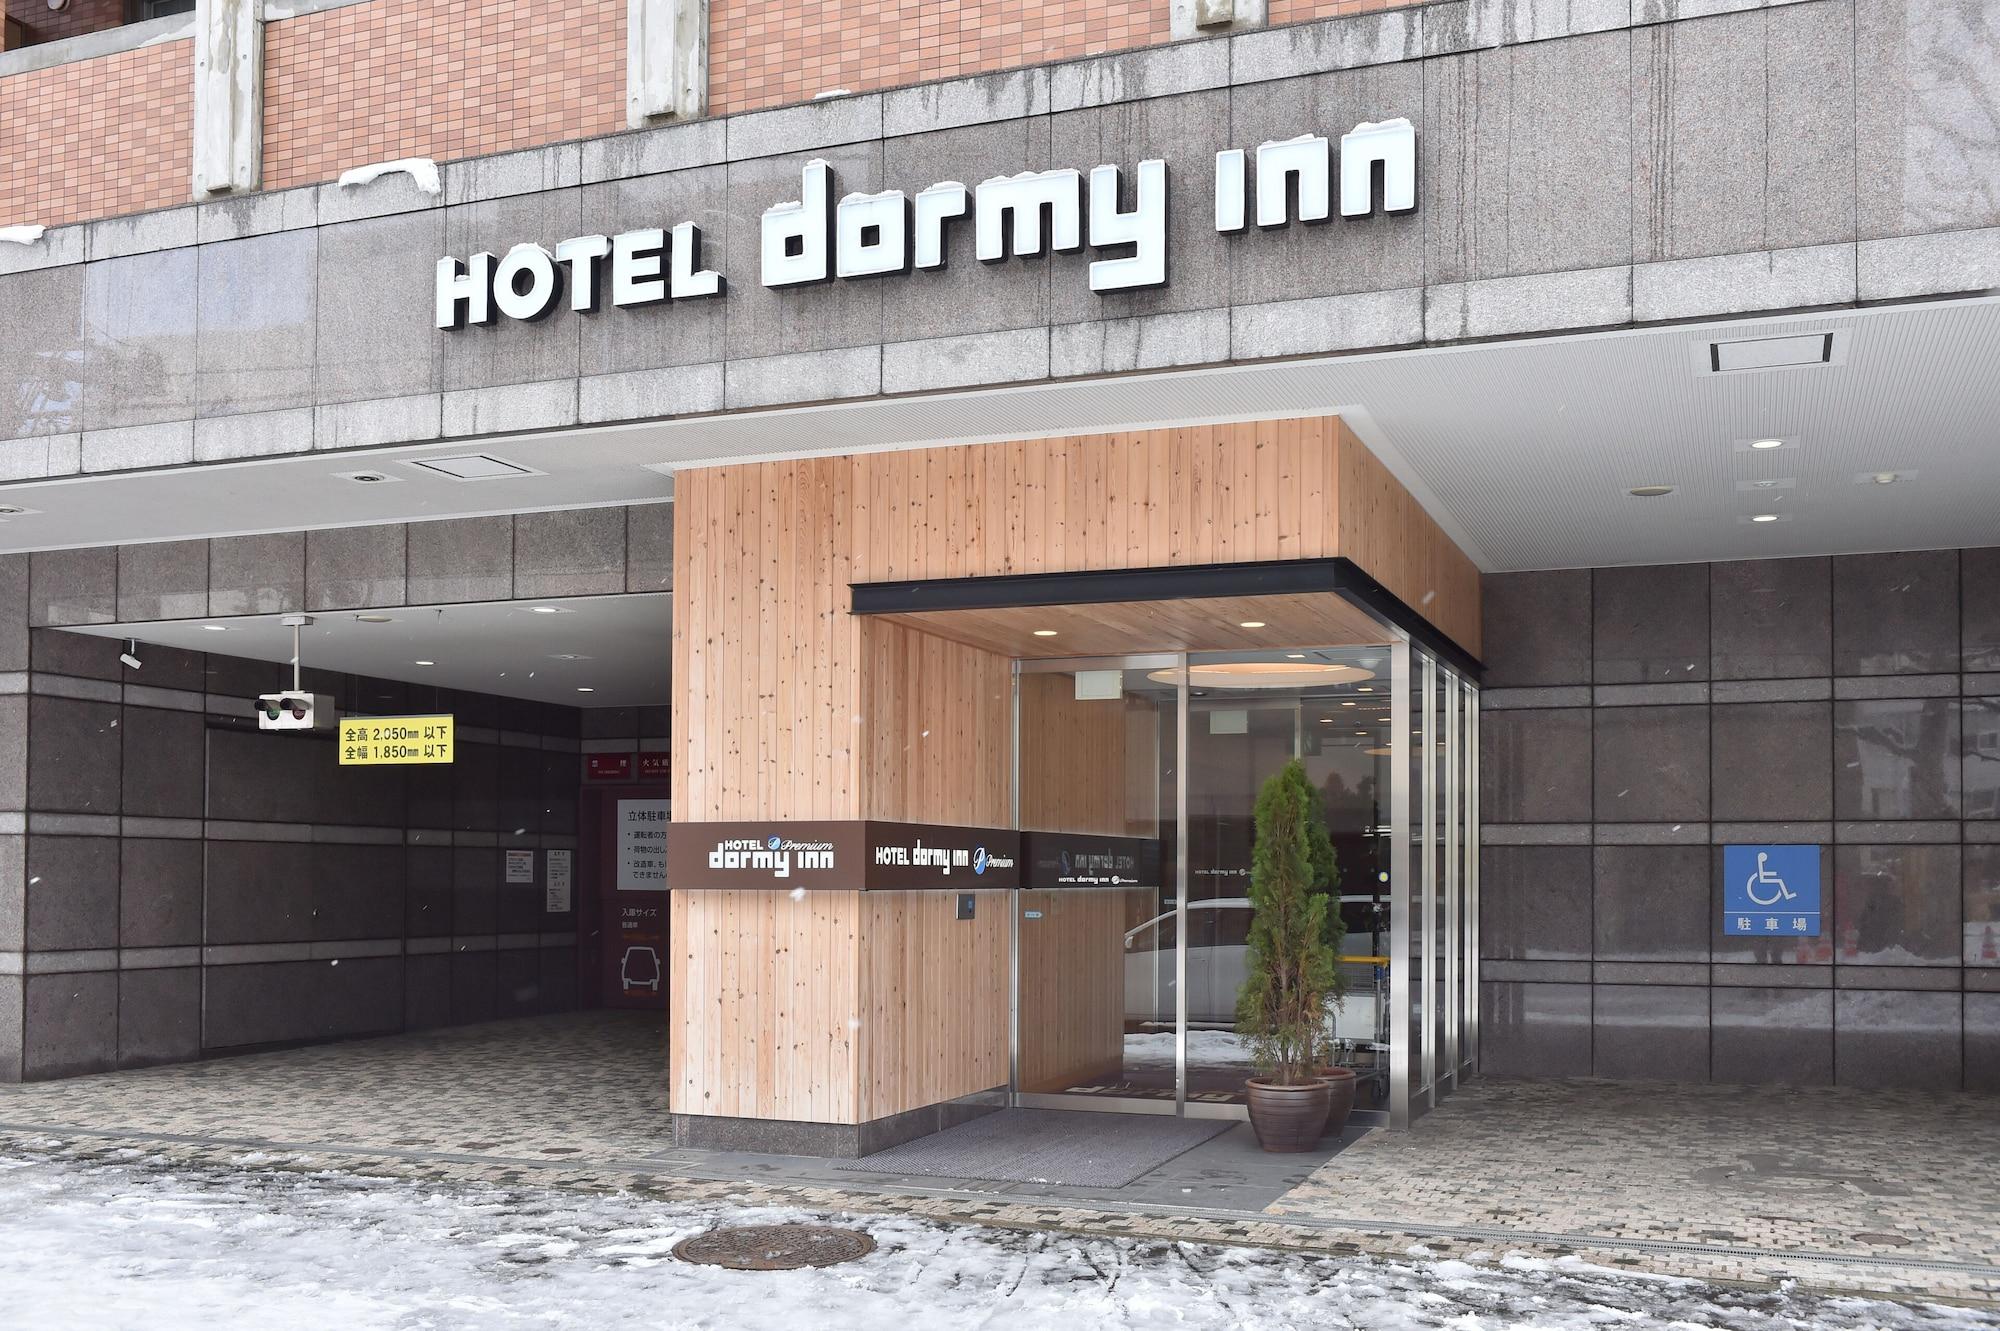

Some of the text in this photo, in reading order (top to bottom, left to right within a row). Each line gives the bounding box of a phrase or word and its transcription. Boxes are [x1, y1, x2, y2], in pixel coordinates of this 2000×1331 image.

[437, 222, 725, 331] HOTEL
[762, 158, 1169, 292] dormy
[345, 728, 368, 741] 全高
[424, 726, 447, 739] 以下
[345, 746, 368, 759] 全幅
[424, 744, 447, 758] 以下
[725, 840, 763, 850] HOTEL
[781, 840, 834, 851] Premium
[709, 843, 789, 877] dormy
[876, 847, 910, 865] HOTEL
[913, 839, 950, 875] dormy
[1737, 917, 1807, 931] 駐車場
